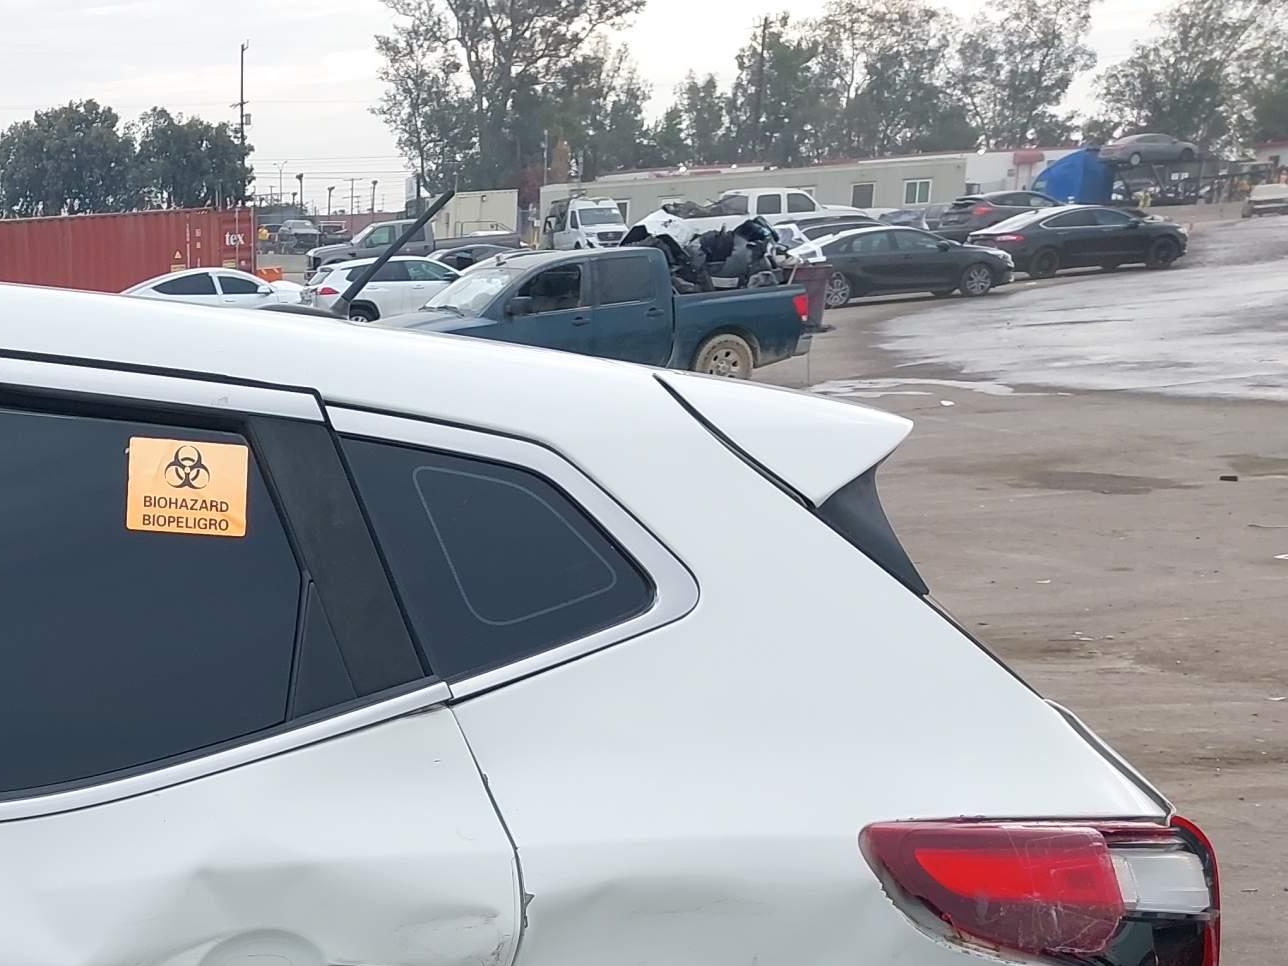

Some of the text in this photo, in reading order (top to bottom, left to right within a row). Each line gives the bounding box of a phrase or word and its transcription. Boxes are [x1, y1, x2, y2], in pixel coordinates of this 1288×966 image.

[225, 231, 245, 247] tex
[143, 495, 229, 513] BIOHAZARD
[142, 513, 229, 531] BIOPELIGRO
